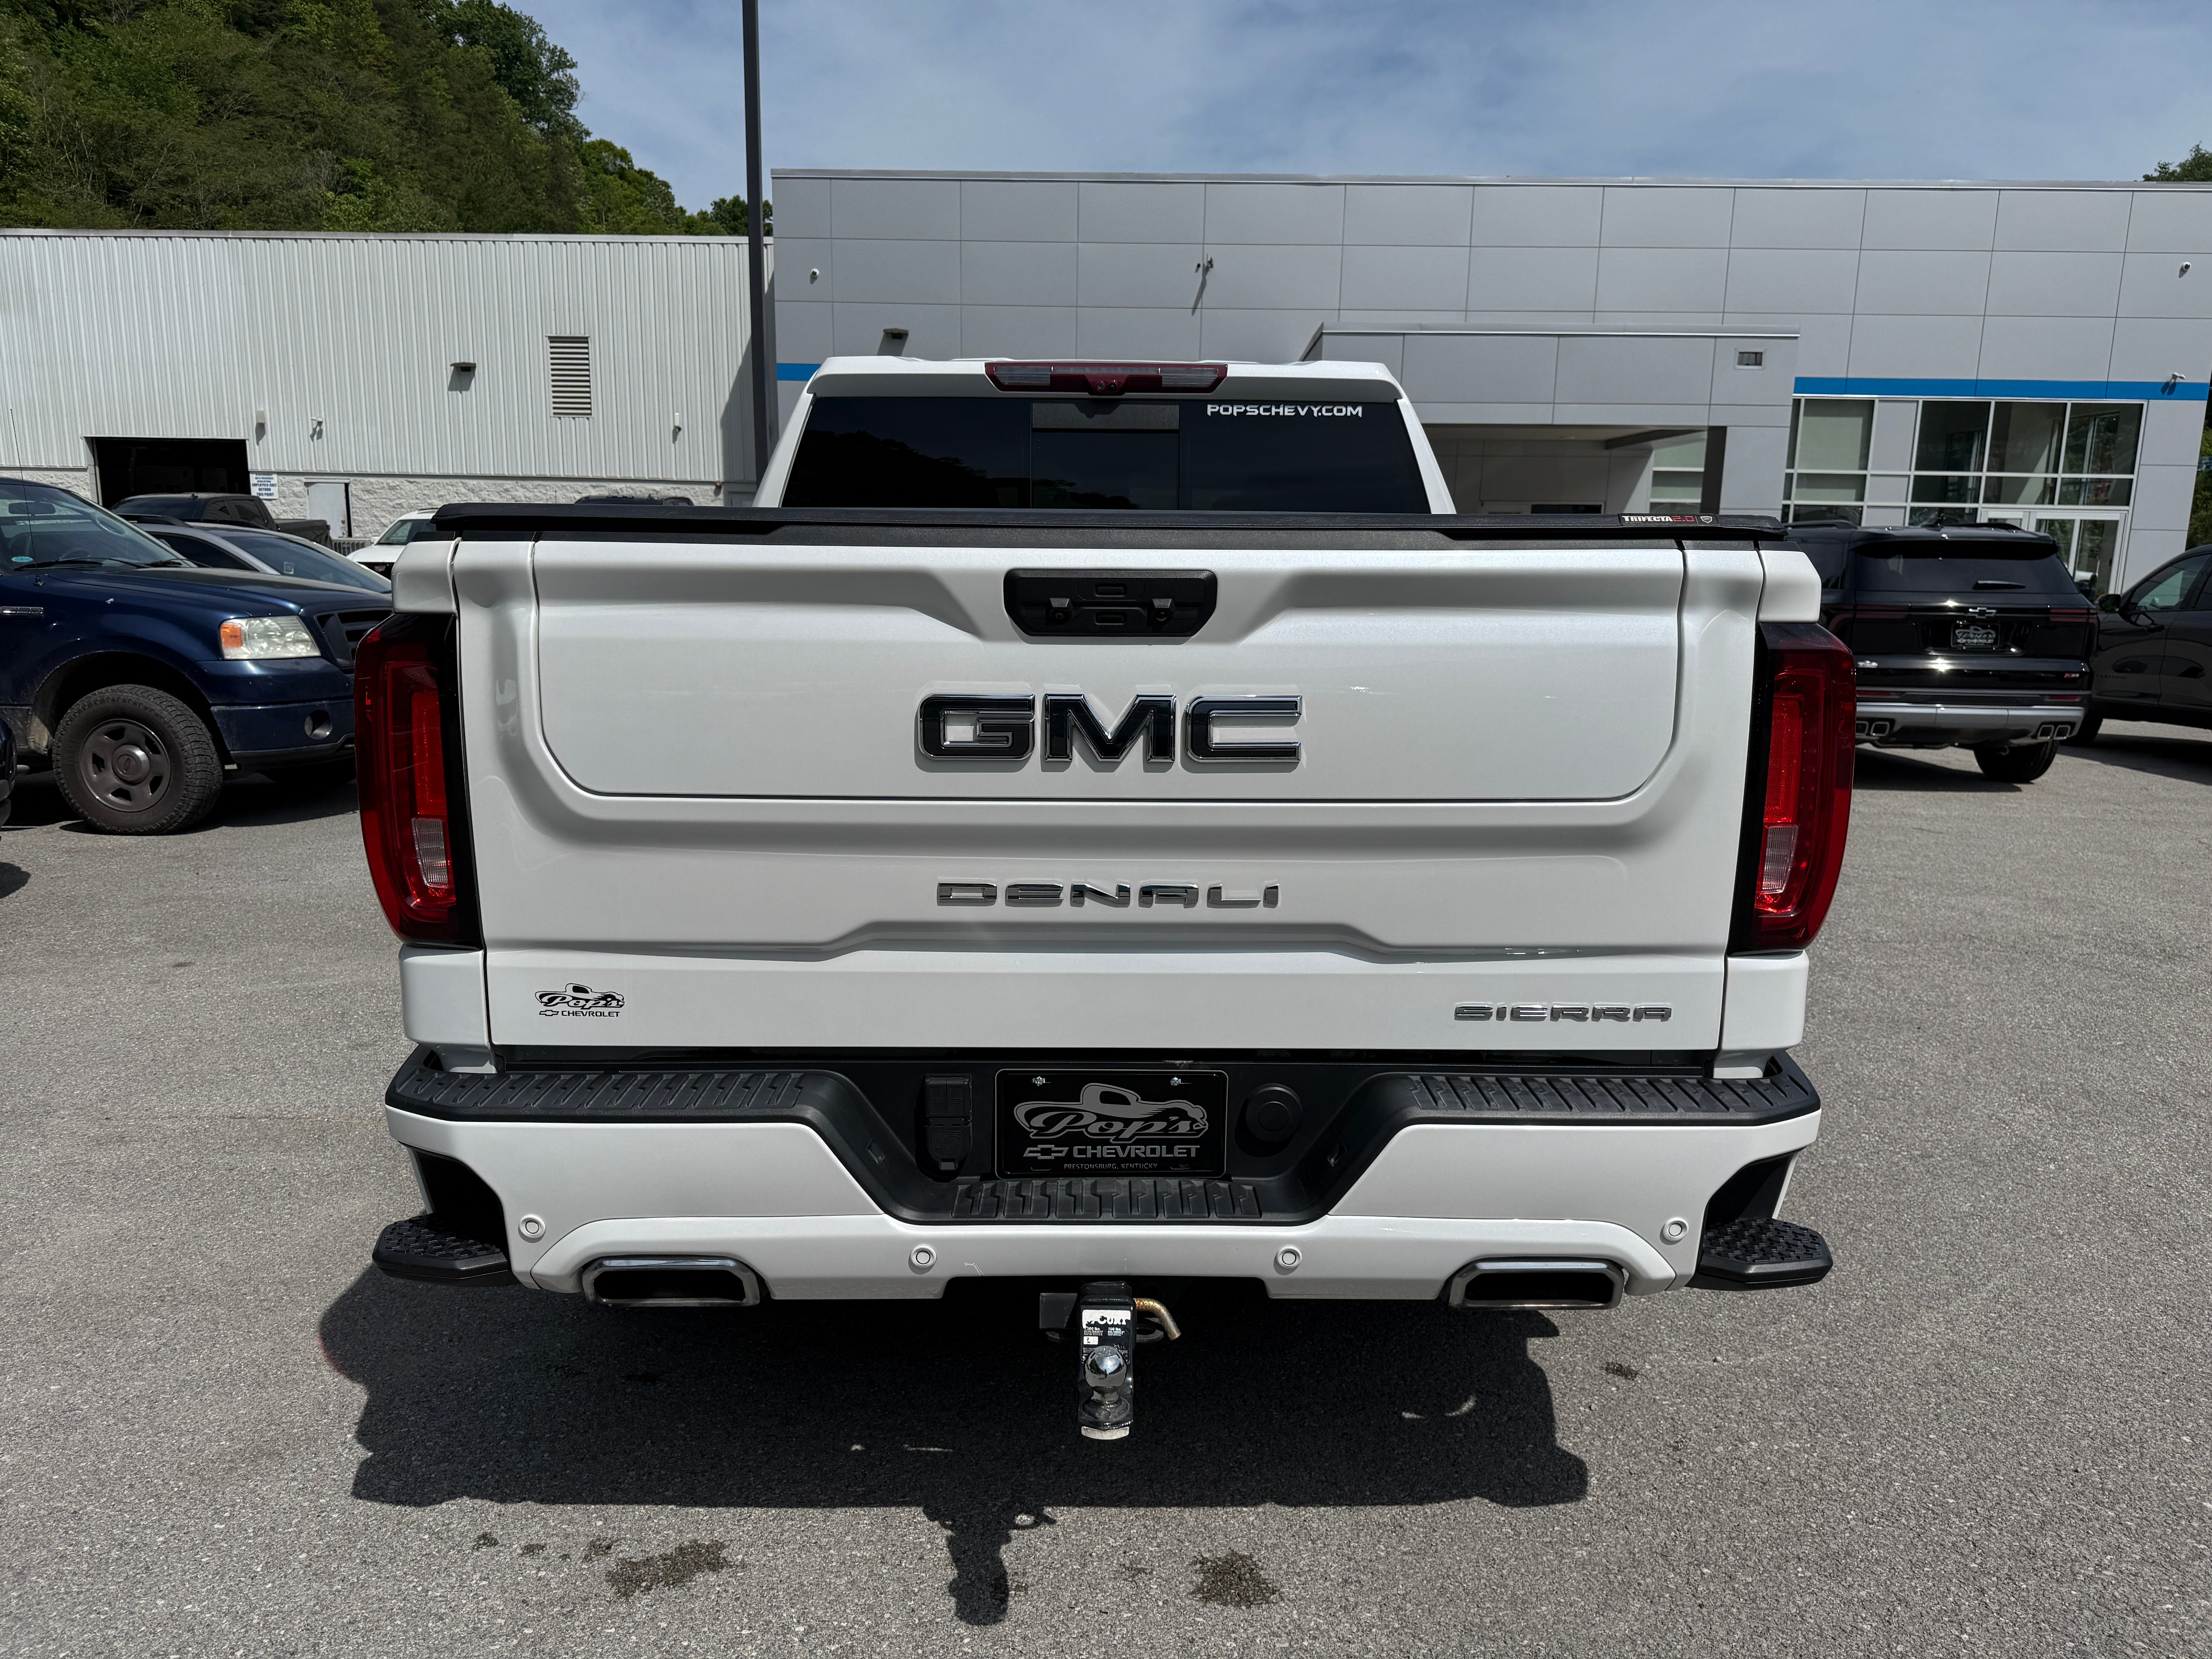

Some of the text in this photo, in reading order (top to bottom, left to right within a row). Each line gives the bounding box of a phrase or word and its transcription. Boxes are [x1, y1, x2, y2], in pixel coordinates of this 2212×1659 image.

[1207, 404, 1362, 417] POPSCHEVY.COM
[919, 693, 1303, 762] GMC
[936, 882, 1279, 908] DENALI
[1455, 1006, 1673, 1022] SIERRA
[1073, 1145, 1200, 1158] CHEVROLET
